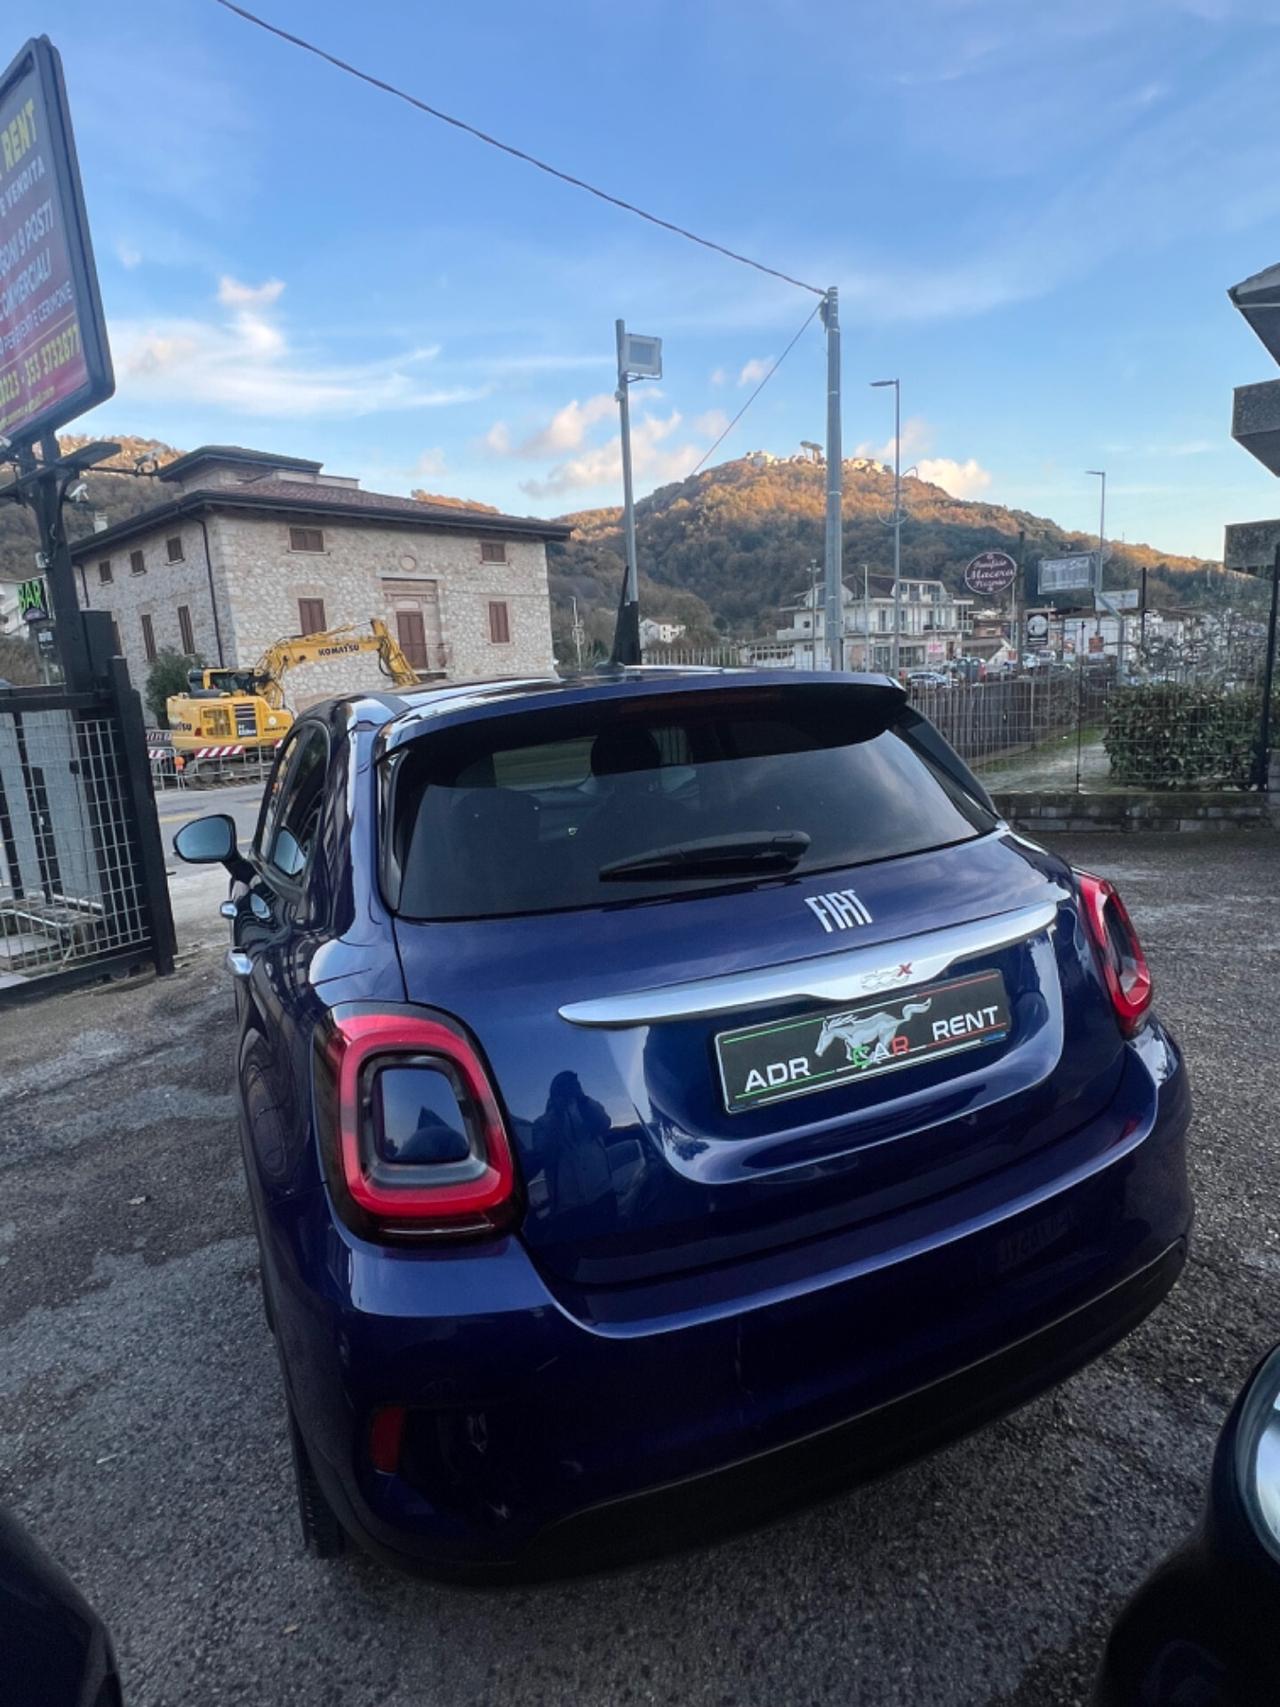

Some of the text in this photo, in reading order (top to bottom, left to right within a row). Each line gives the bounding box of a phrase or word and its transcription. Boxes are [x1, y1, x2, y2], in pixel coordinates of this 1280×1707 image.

[1, 98, 37, 173] RENT
[5, 156, 45, 208] VENDITA
[25, 199, 54, 249] POSTI
[17, 580, 41, 614] BAR
[318, 643, 360, 656] KOMATSU
[804, 889, 873, 933] FIAT
[745, 1005, 999, 1093] ADR CAR RENT
